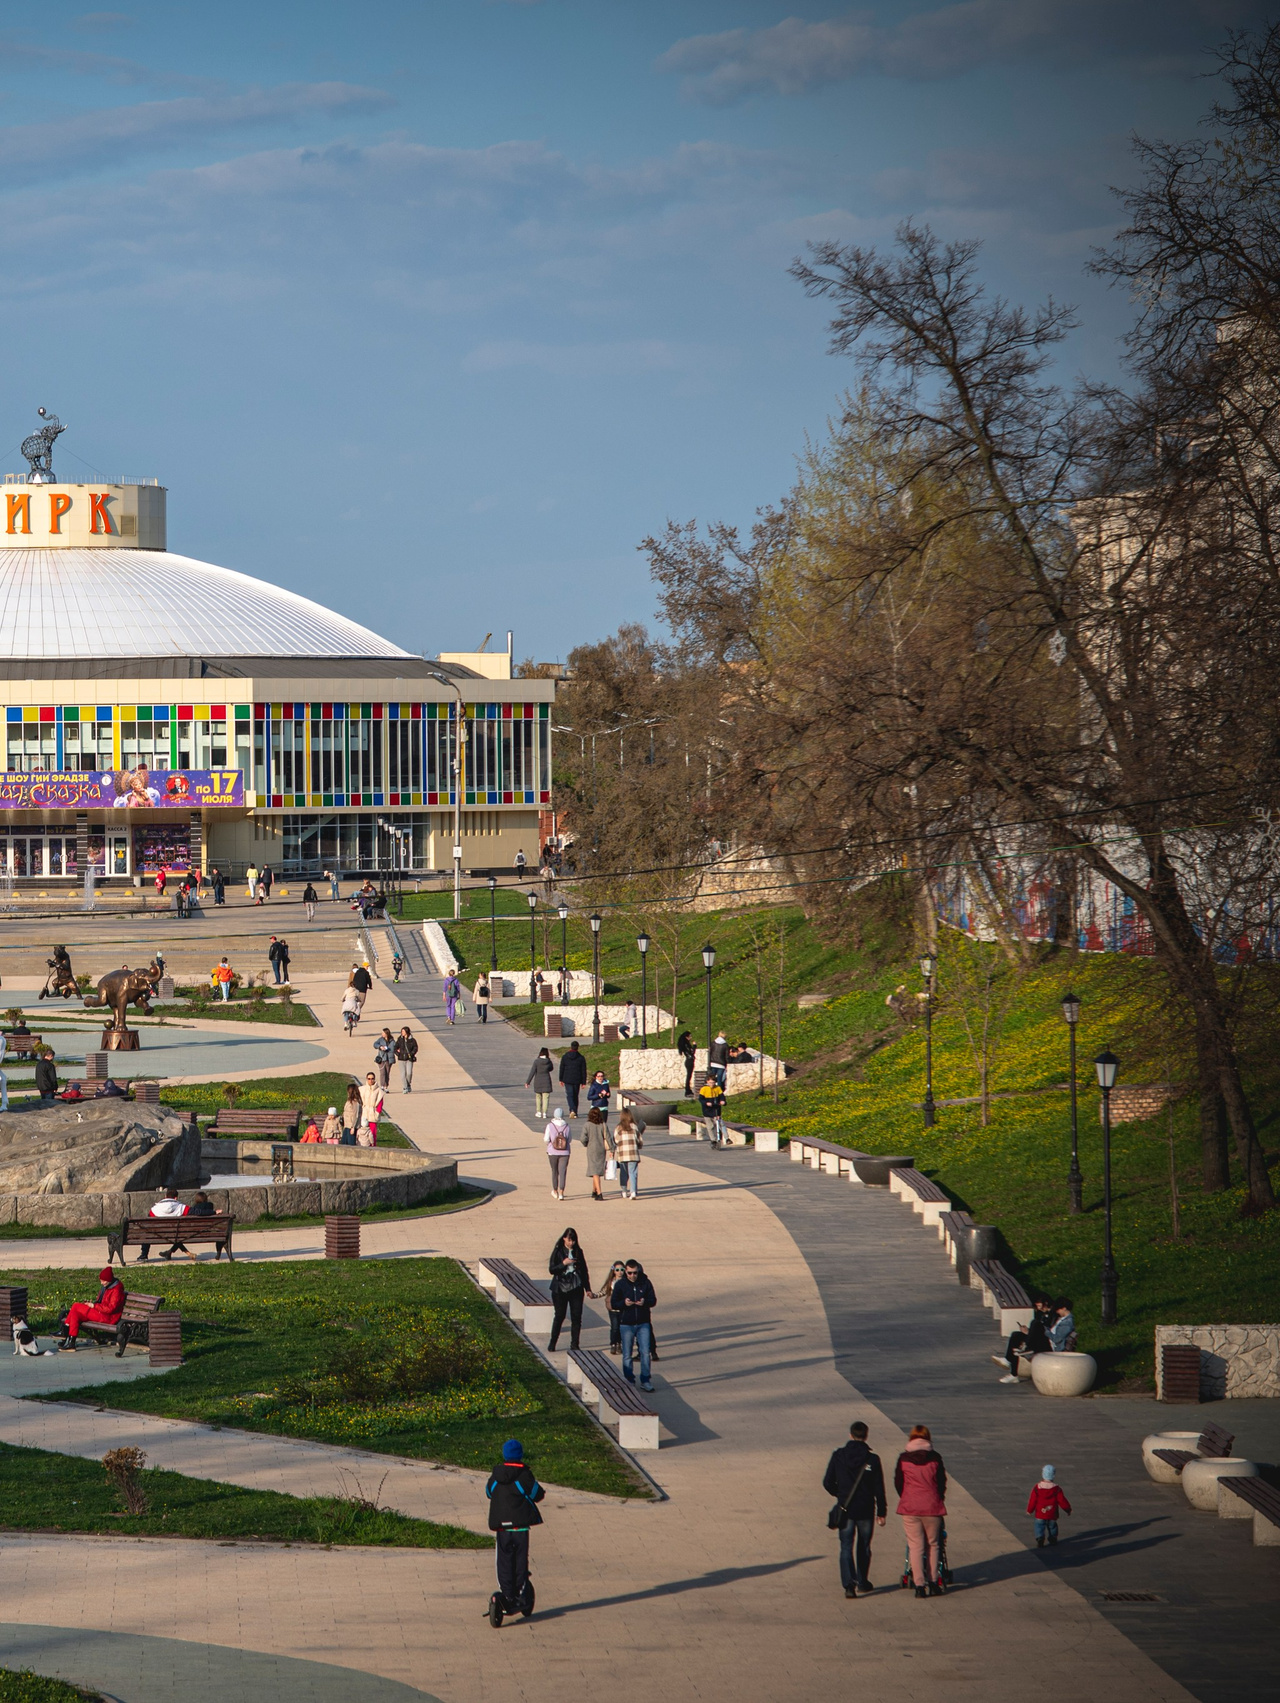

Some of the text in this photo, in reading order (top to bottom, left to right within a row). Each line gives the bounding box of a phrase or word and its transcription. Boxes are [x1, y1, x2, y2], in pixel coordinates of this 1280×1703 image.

[7, 774, 29, 783] ШОУ
[31, 774, 50, 783] ГИИ
[51, 774, 89, 783] ЭРАДЗЕ
[211, 773, 238, 794] 17
[202, 795, 232, 804] ИЮЛЯ
